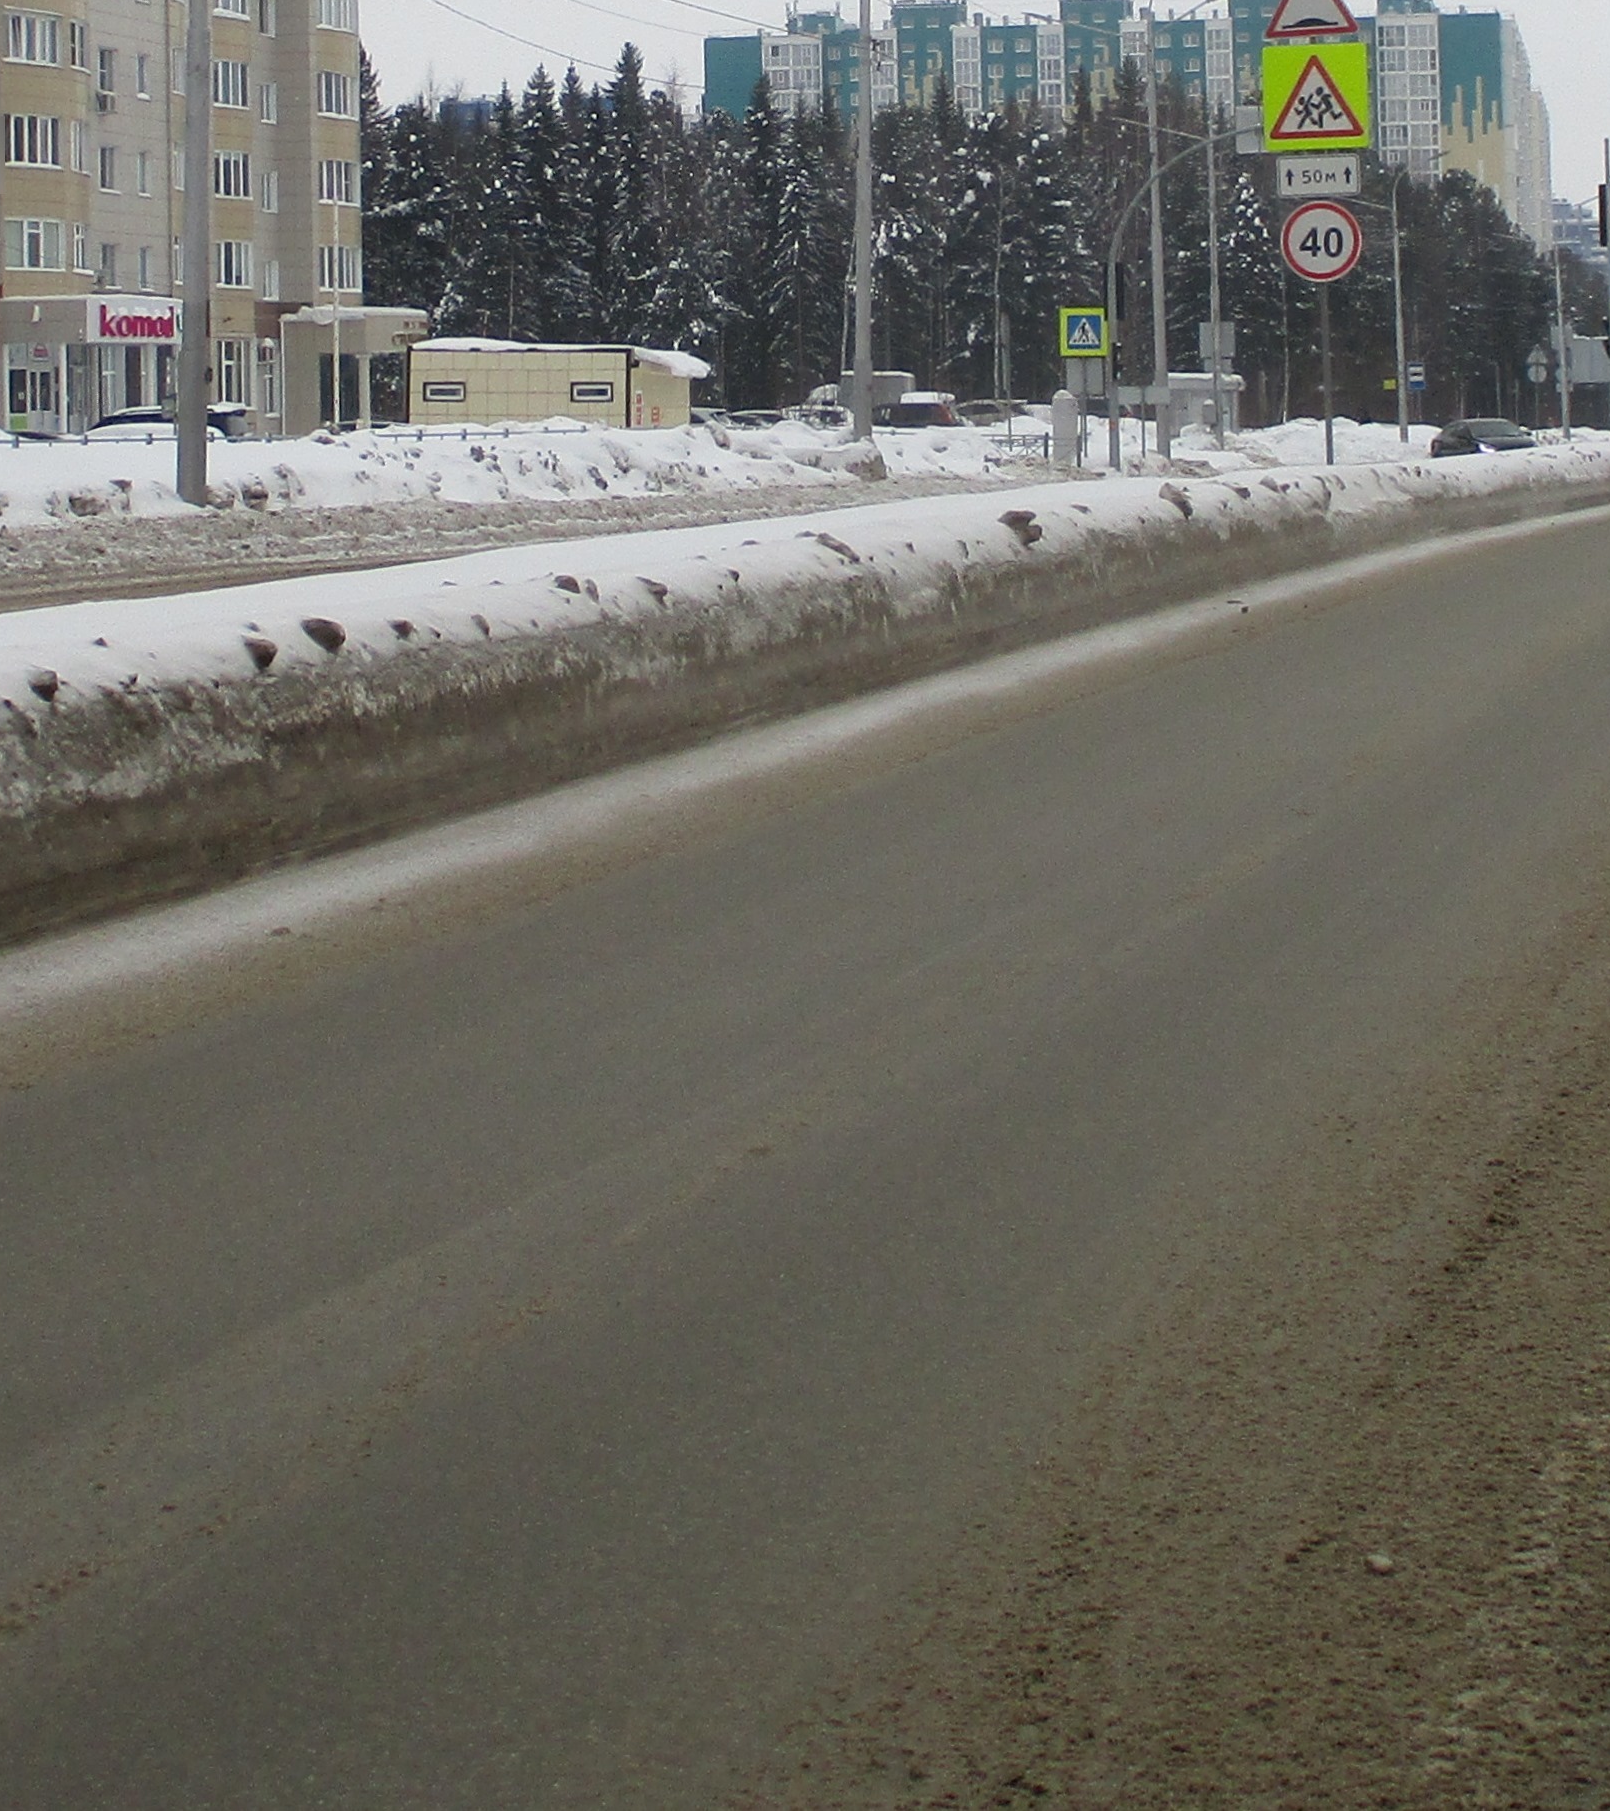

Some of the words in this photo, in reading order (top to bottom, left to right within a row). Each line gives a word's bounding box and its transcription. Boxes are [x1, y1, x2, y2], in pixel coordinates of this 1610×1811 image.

[1301, 169, 1337, 185] 50м
[1299, 226, 1343, 258] 40
[99, 303, 174, 338] komod
